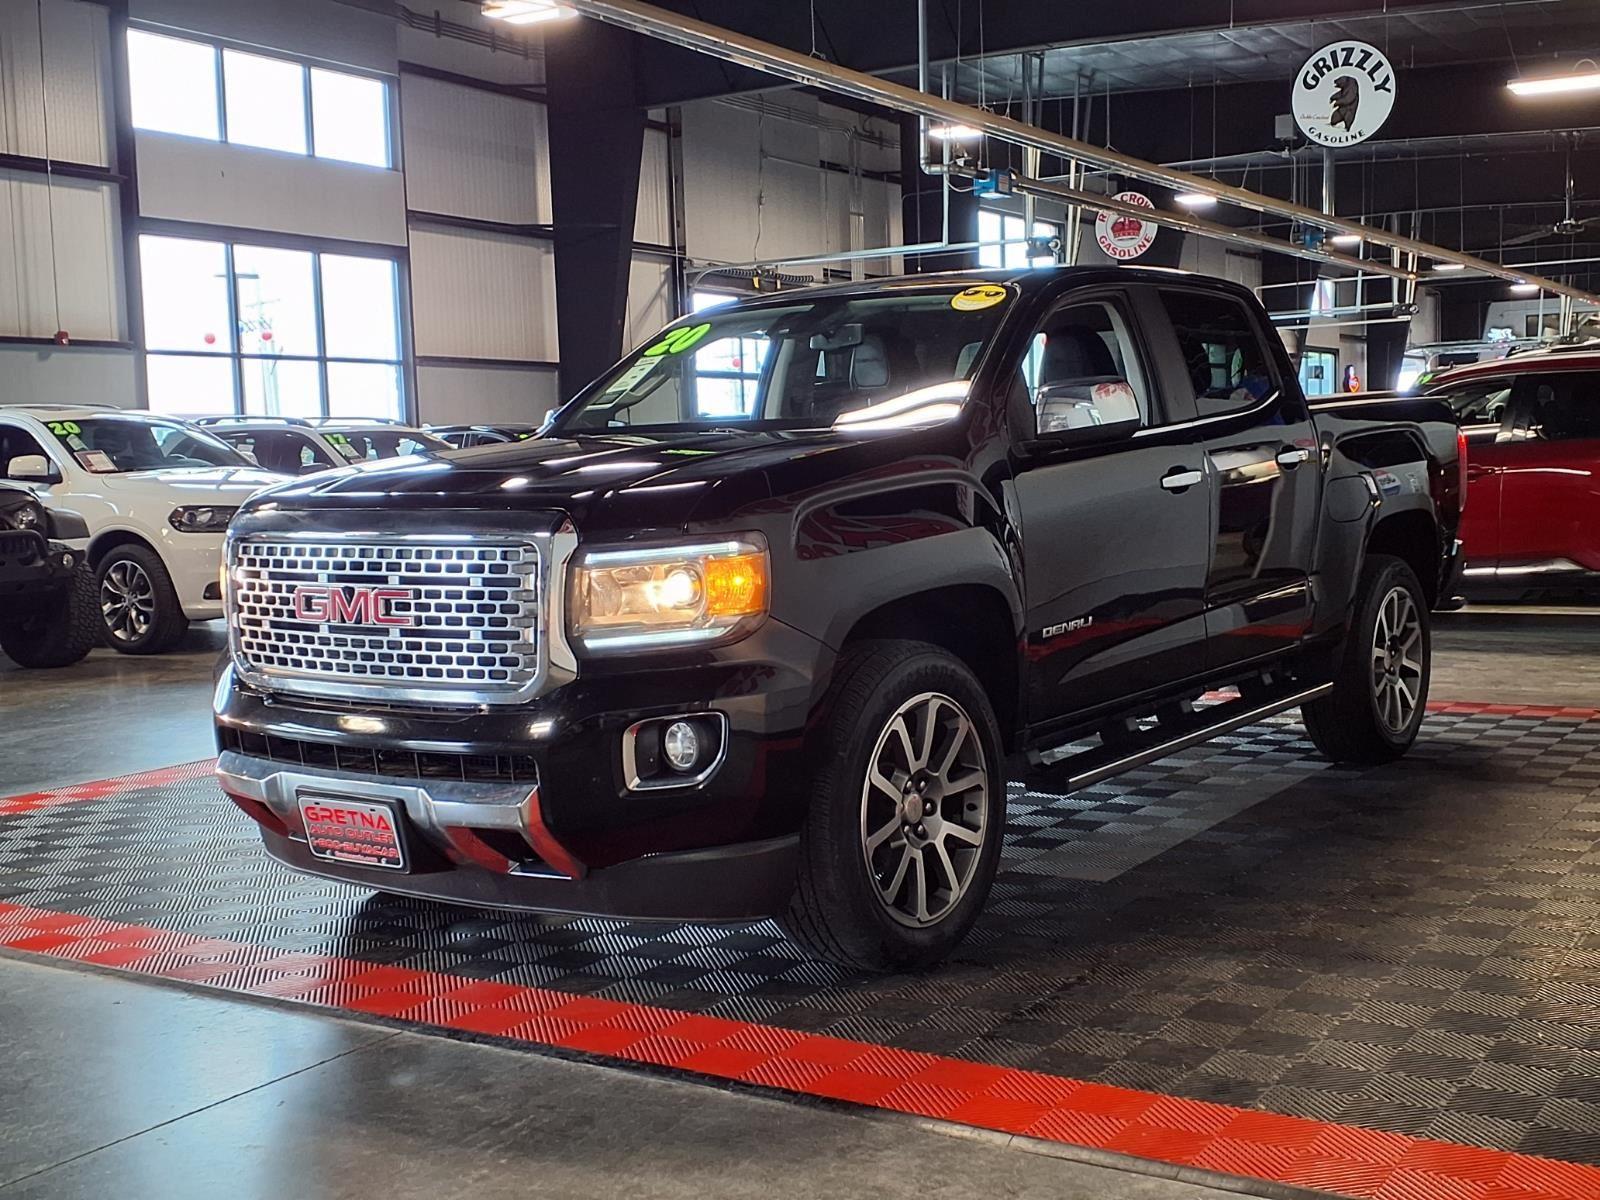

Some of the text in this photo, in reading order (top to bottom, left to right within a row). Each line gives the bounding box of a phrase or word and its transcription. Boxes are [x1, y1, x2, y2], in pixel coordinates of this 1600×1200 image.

[1302, 47, 1392, 93] GRIZZLY
[1308, 126, 1366, 143] GASOLINE
[1120, 193, 1152, 209] CRO
[1100, 233, 1153, 257] GASOLINE
[643, 322, 713, 357] 20
[47, 421, 81, 435] 20
[295, 586, 415, 626] GMC
[1042, 615, 1093, 639] DENALI
[304, 806, 391, 830] GRETNA
[309, 823, 394, 844] AUTO OUTLET
